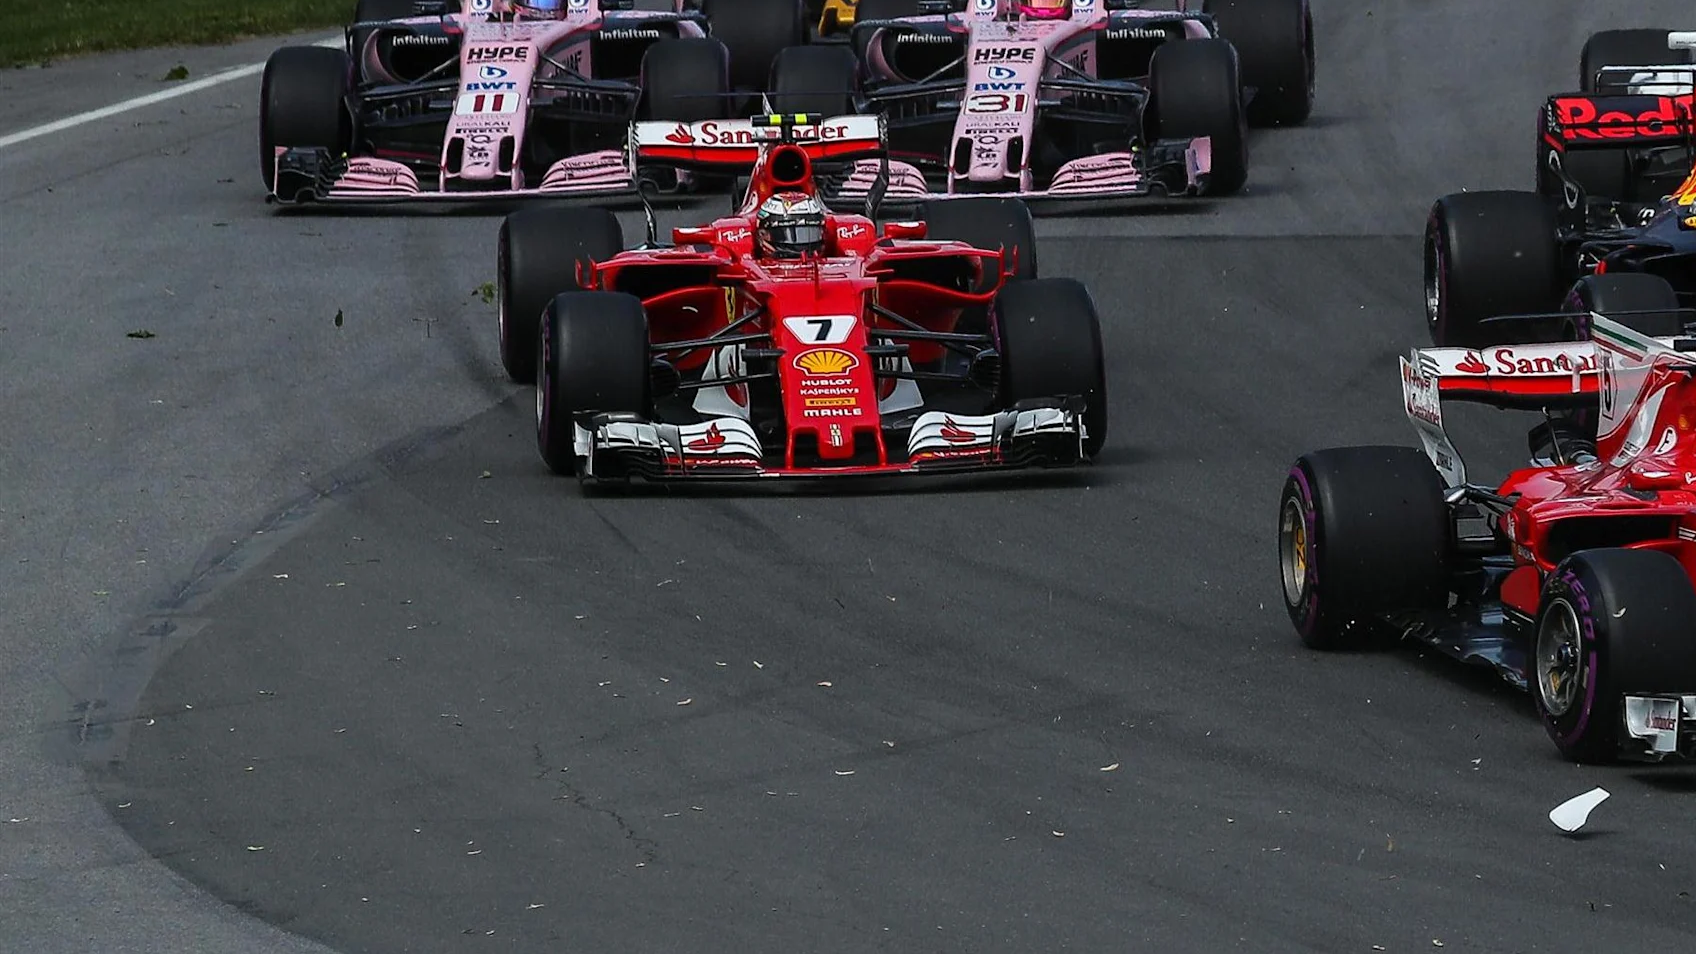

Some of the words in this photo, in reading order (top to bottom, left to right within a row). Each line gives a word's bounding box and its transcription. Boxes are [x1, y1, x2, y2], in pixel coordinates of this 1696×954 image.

[468, 47, 528, 59] HYPE
[974, 48, 1036, 60] HYPE
[466, 82, 516, 91] BWT
[974, 83, 1025, 91] BWT
[473, 94, 505, 112] 11
[968, 94, 1025, 113] 31
[701, 123, 850, 144] Sander
[806, 319, 832, 341] 7
[804, 408, 862, 417] MAHLE
